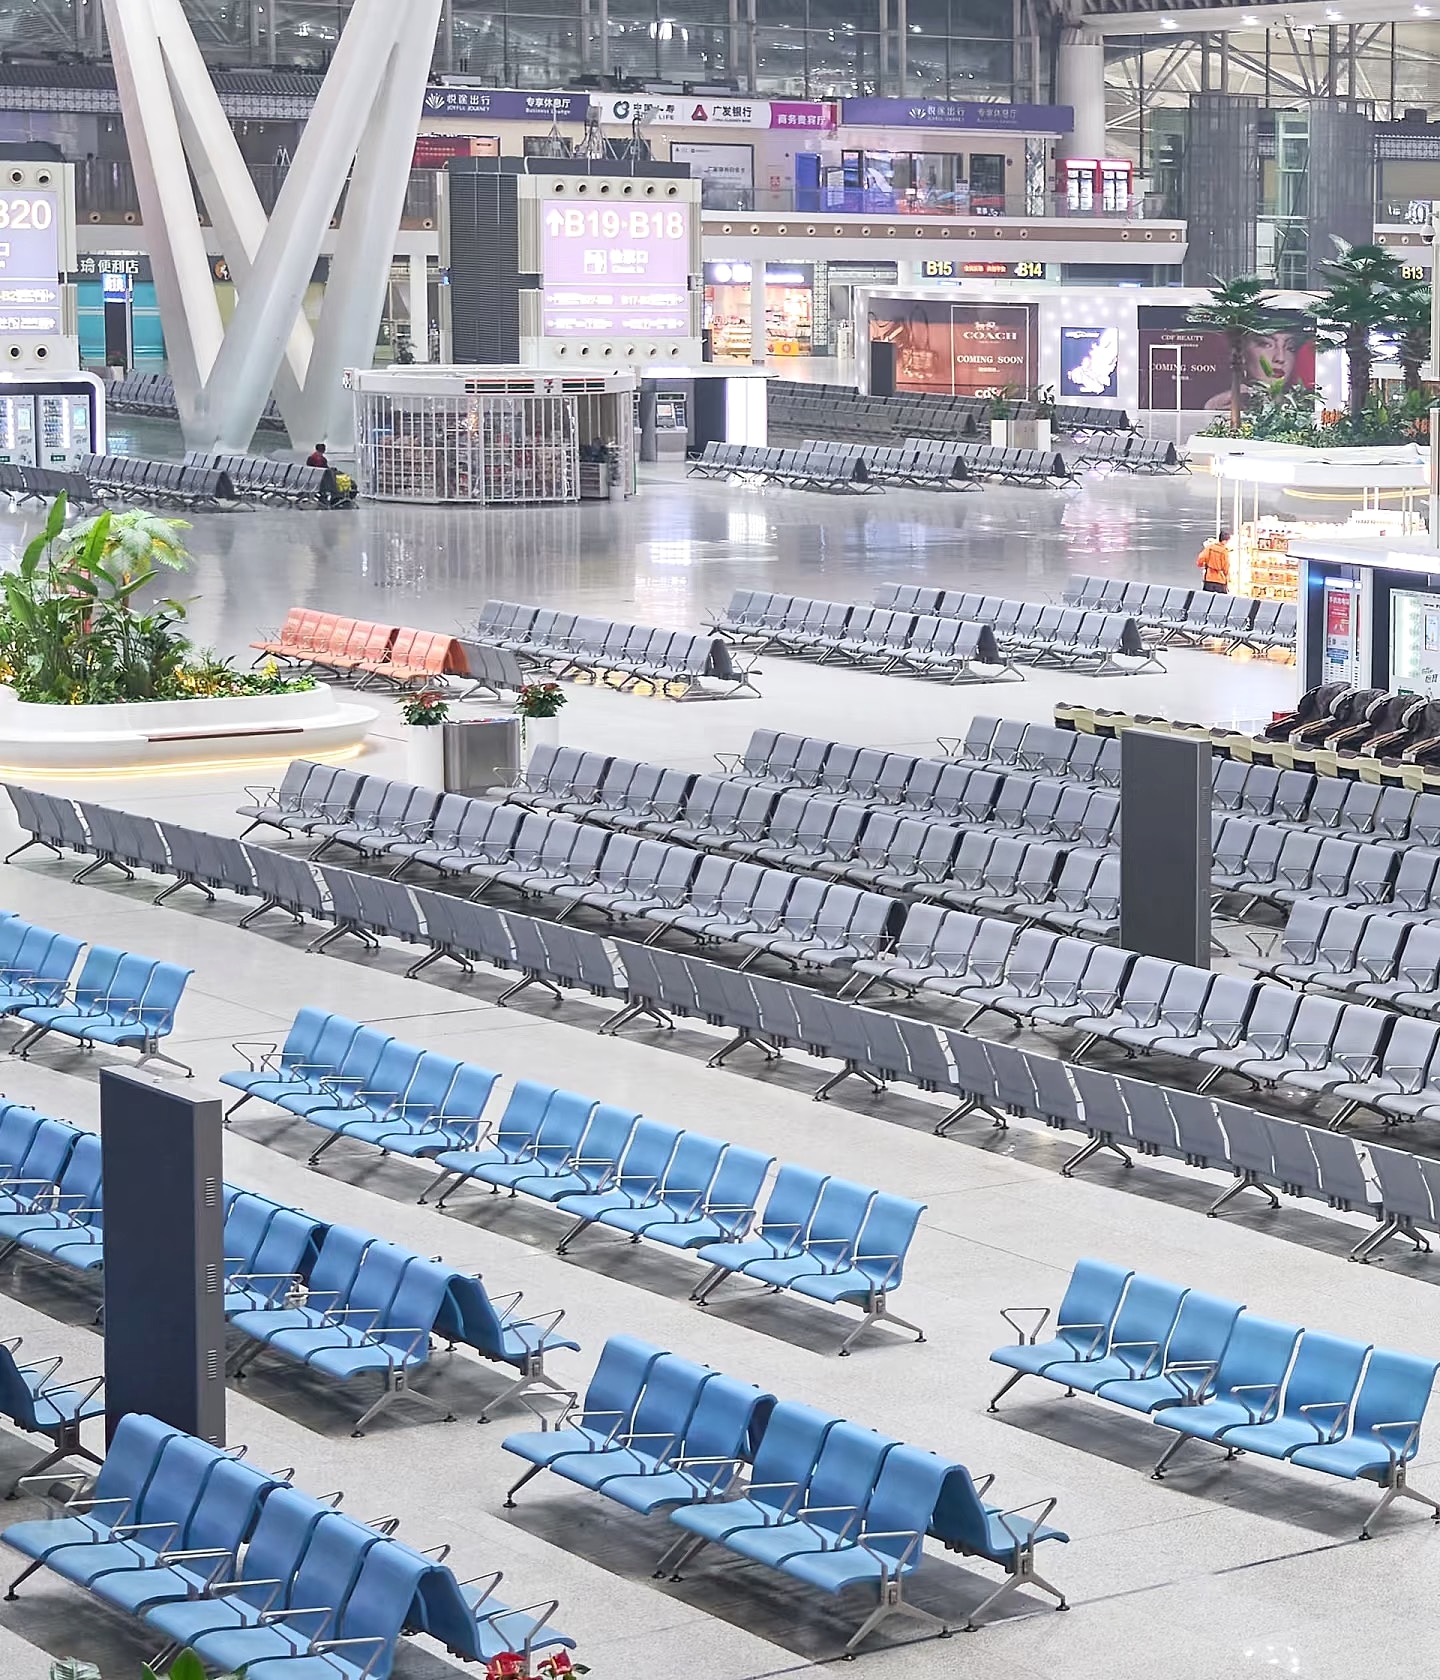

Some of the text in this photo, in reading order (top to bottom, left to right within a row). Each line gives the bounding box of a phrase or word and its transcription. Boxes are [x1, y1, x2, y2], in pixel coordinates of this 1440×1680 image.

[446, 94, 490, 105] 悦途出行
[712, 105, 752, 118] 广发银行
[926, 260, 953, 275] B15
[1018, 262, 1043, 277] B14
[1402, 266, 1424, 279] B13
[963, 331, 1017, 340] COACH
[1176, 334, 1204, 342] BEAUTY
[956, 355, 1024, 364] COMING SOON
[1190, 364, 1217, 372] SOON
